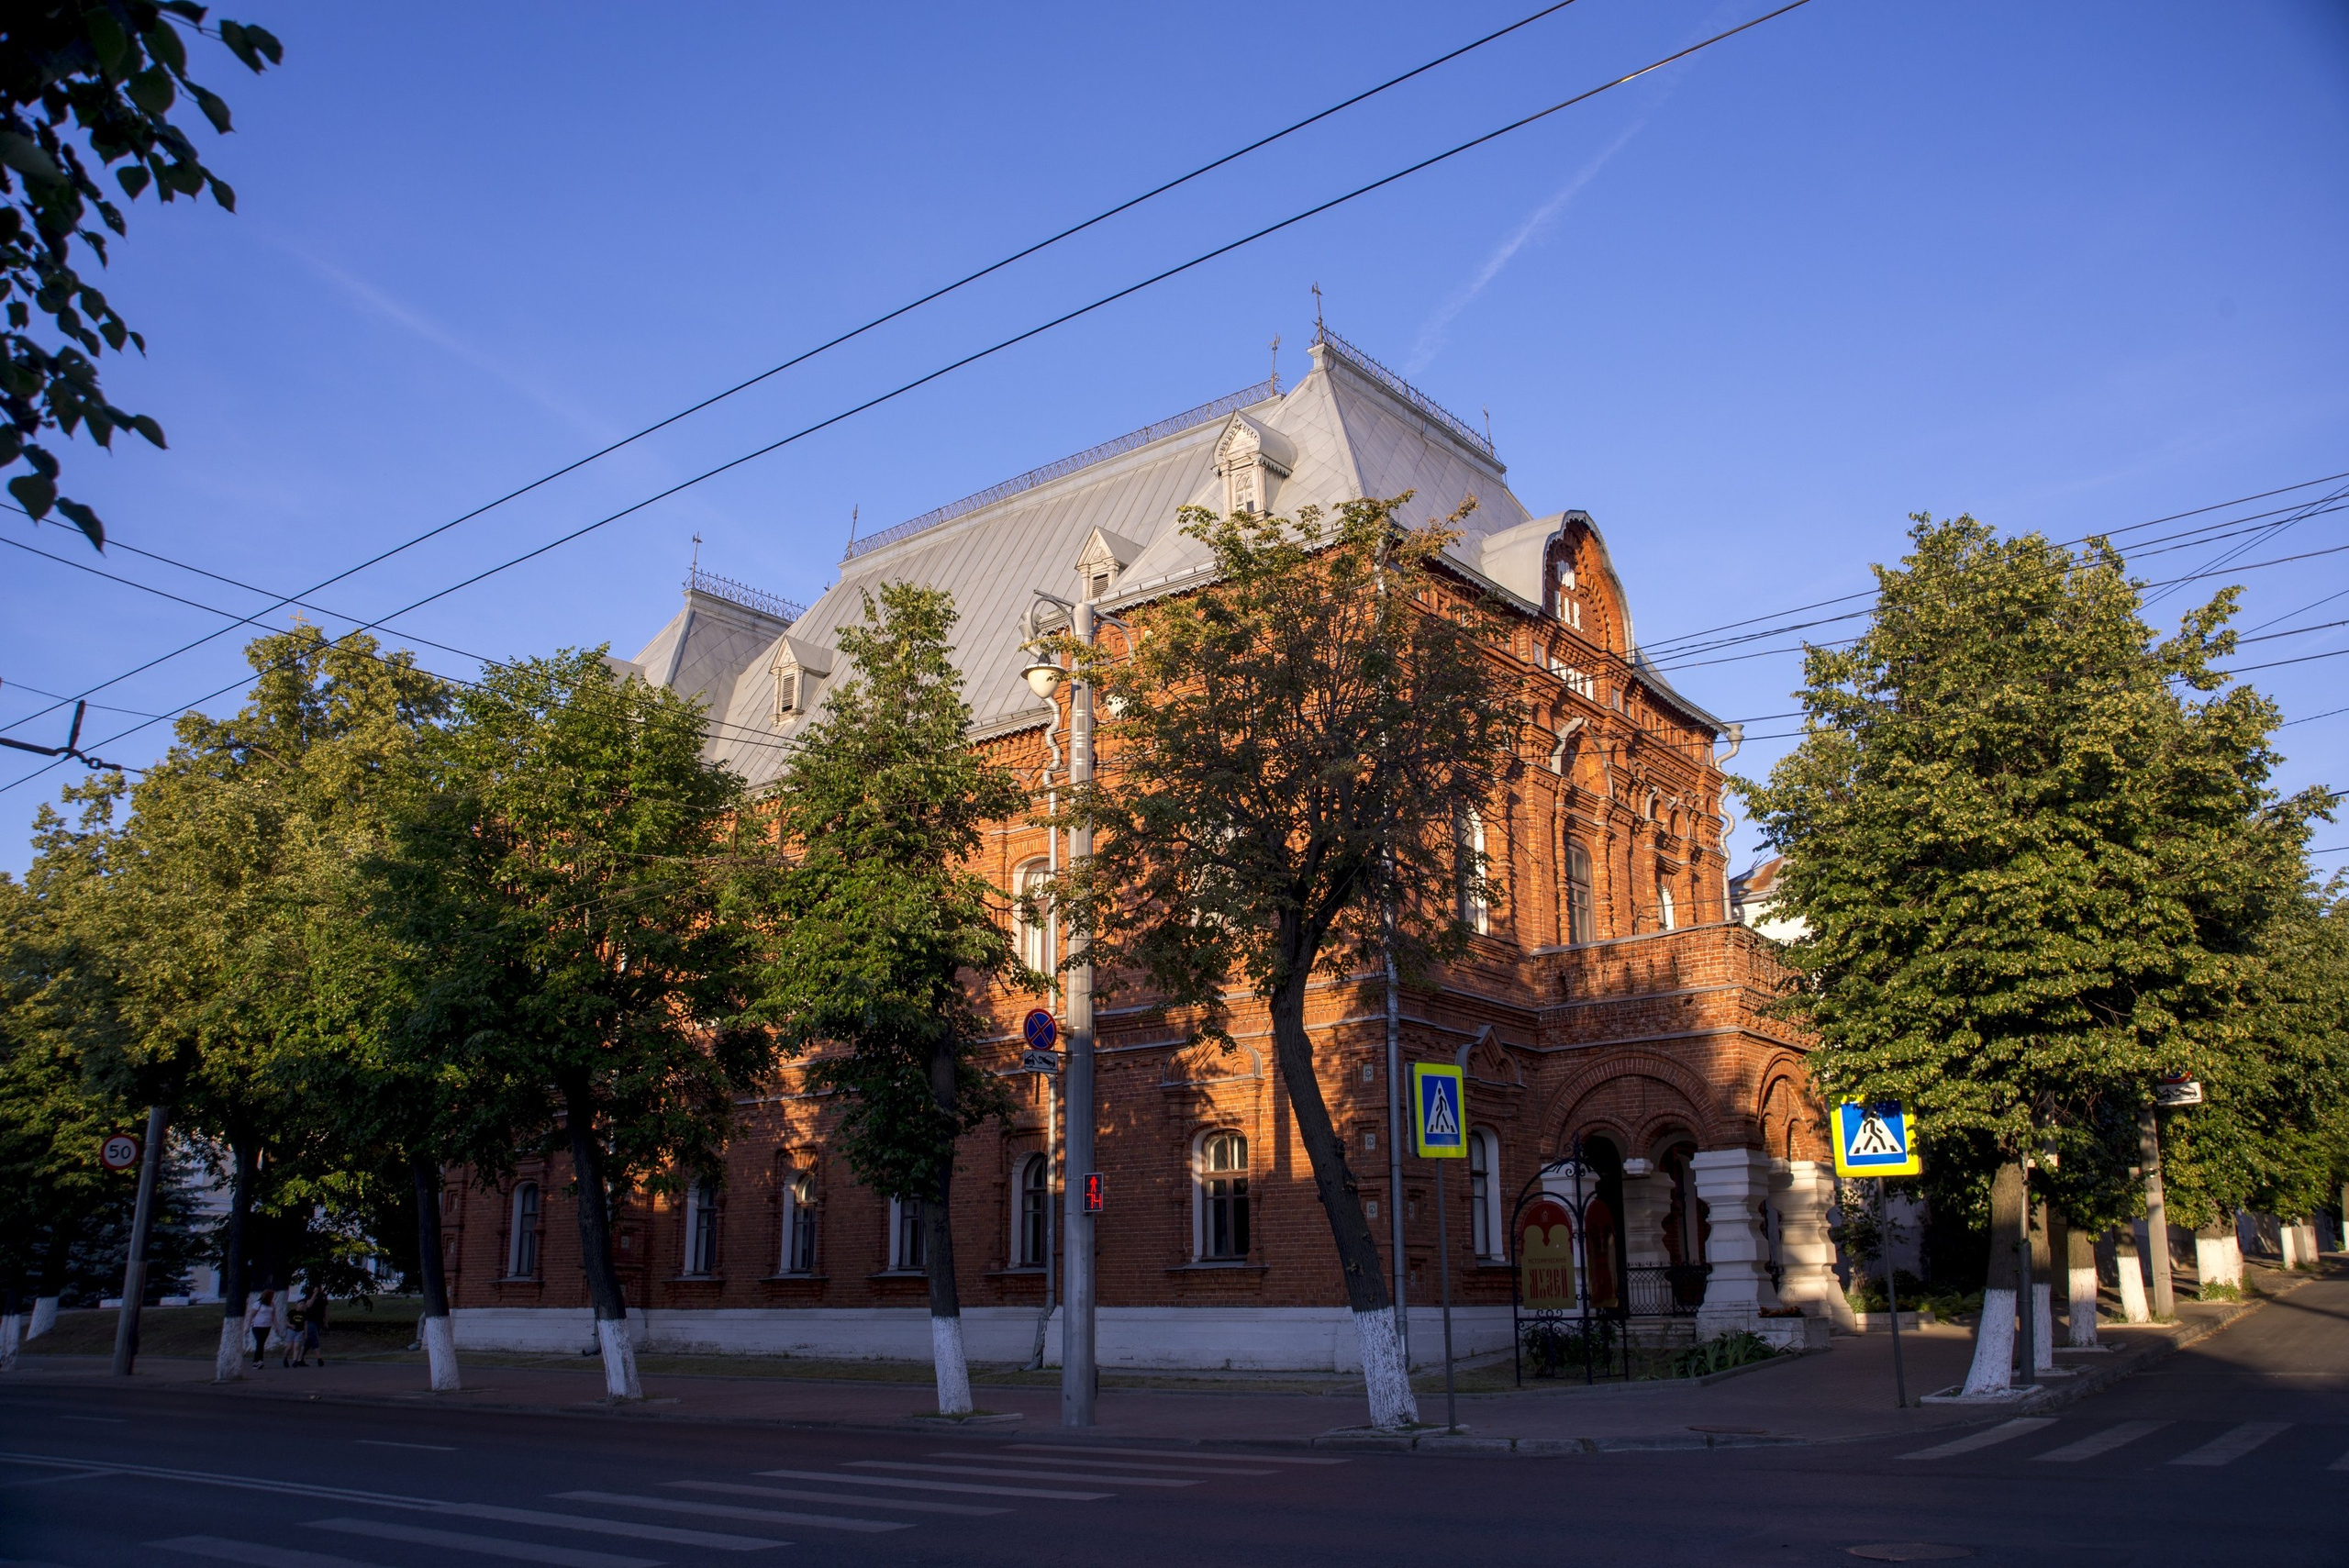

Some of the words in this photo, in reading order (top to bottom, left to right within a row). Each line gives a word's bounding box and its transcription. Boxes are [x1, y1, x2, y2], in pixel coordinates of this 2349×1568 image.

[109, 1145, 131, 1159] 50
[1086, 1193, 1102, 1209] 74
[1529, 1267, 1568, 1299] МУЗЕЙ
